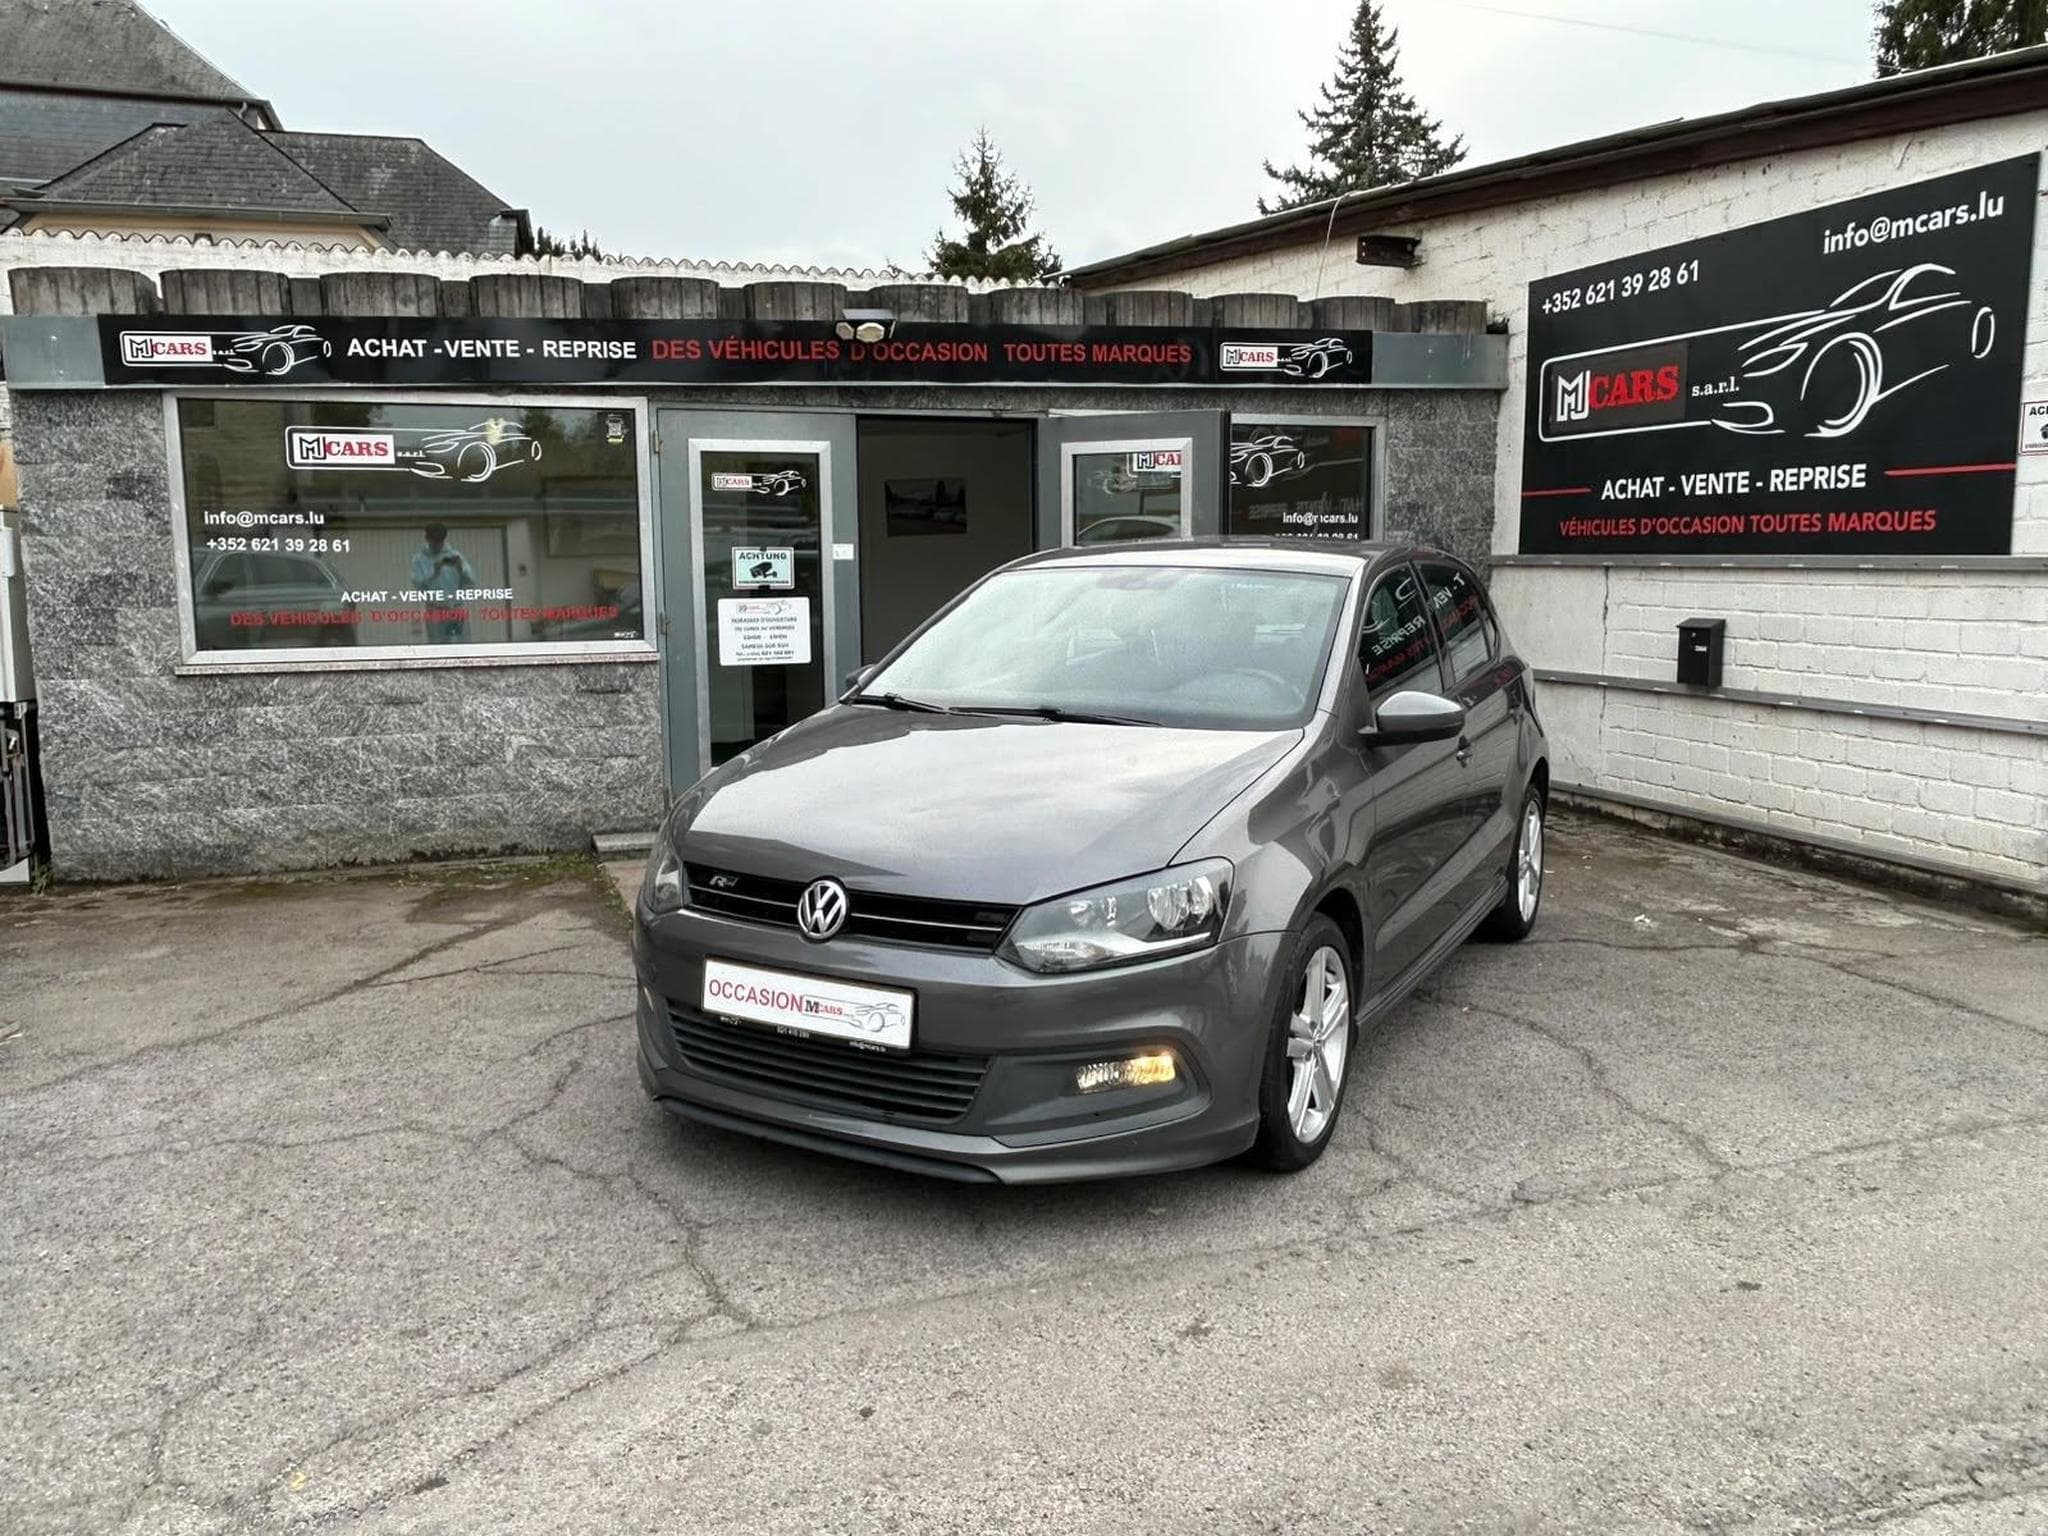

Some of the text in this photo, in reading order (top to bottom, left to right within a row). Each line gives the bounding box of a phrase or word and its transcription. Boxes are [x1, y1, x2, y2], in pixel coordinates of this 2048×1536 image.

[1823, 190, 2005, 254] info@mcars.lu
[1542, 259, 1700, 314] +352 621 39 28 61
[347, 338, 426, 357] ACHAT
[444, 339, 521, 358] VENTE
[542, 339, 637, 359] REPRISE
[652, 340, 700, 360] DES
[708, 335, 839, 360] VÉHICULES
[850, 341, 988, 362] D'OCCASION
[1003, 343, 1086, 363] TOUTES
[1092, 343, 1191, 364] MARQUES
[1691, 376, 1740, 397] s.a.r.l.
[1601, 476, 1665, 500] ACHAT
[1681, 471, 1750, 496] VENTE
[1769, 463, 1868, 492] REPRISE
[1560, 509, 1937, 536] VÉHICULES D'OCCASION TOUTES MARQUES
[206, 538, 351, 553] +352 621 39 28 61
[739, 552, 787, 560] ACHTUNG
[341, 591, 388, 602] ACHAT
[400, 590, 444, 602] VENTE
[456, 588, 513, 600] REPRISE
[709, 979, 803, 1012] OCCASION
